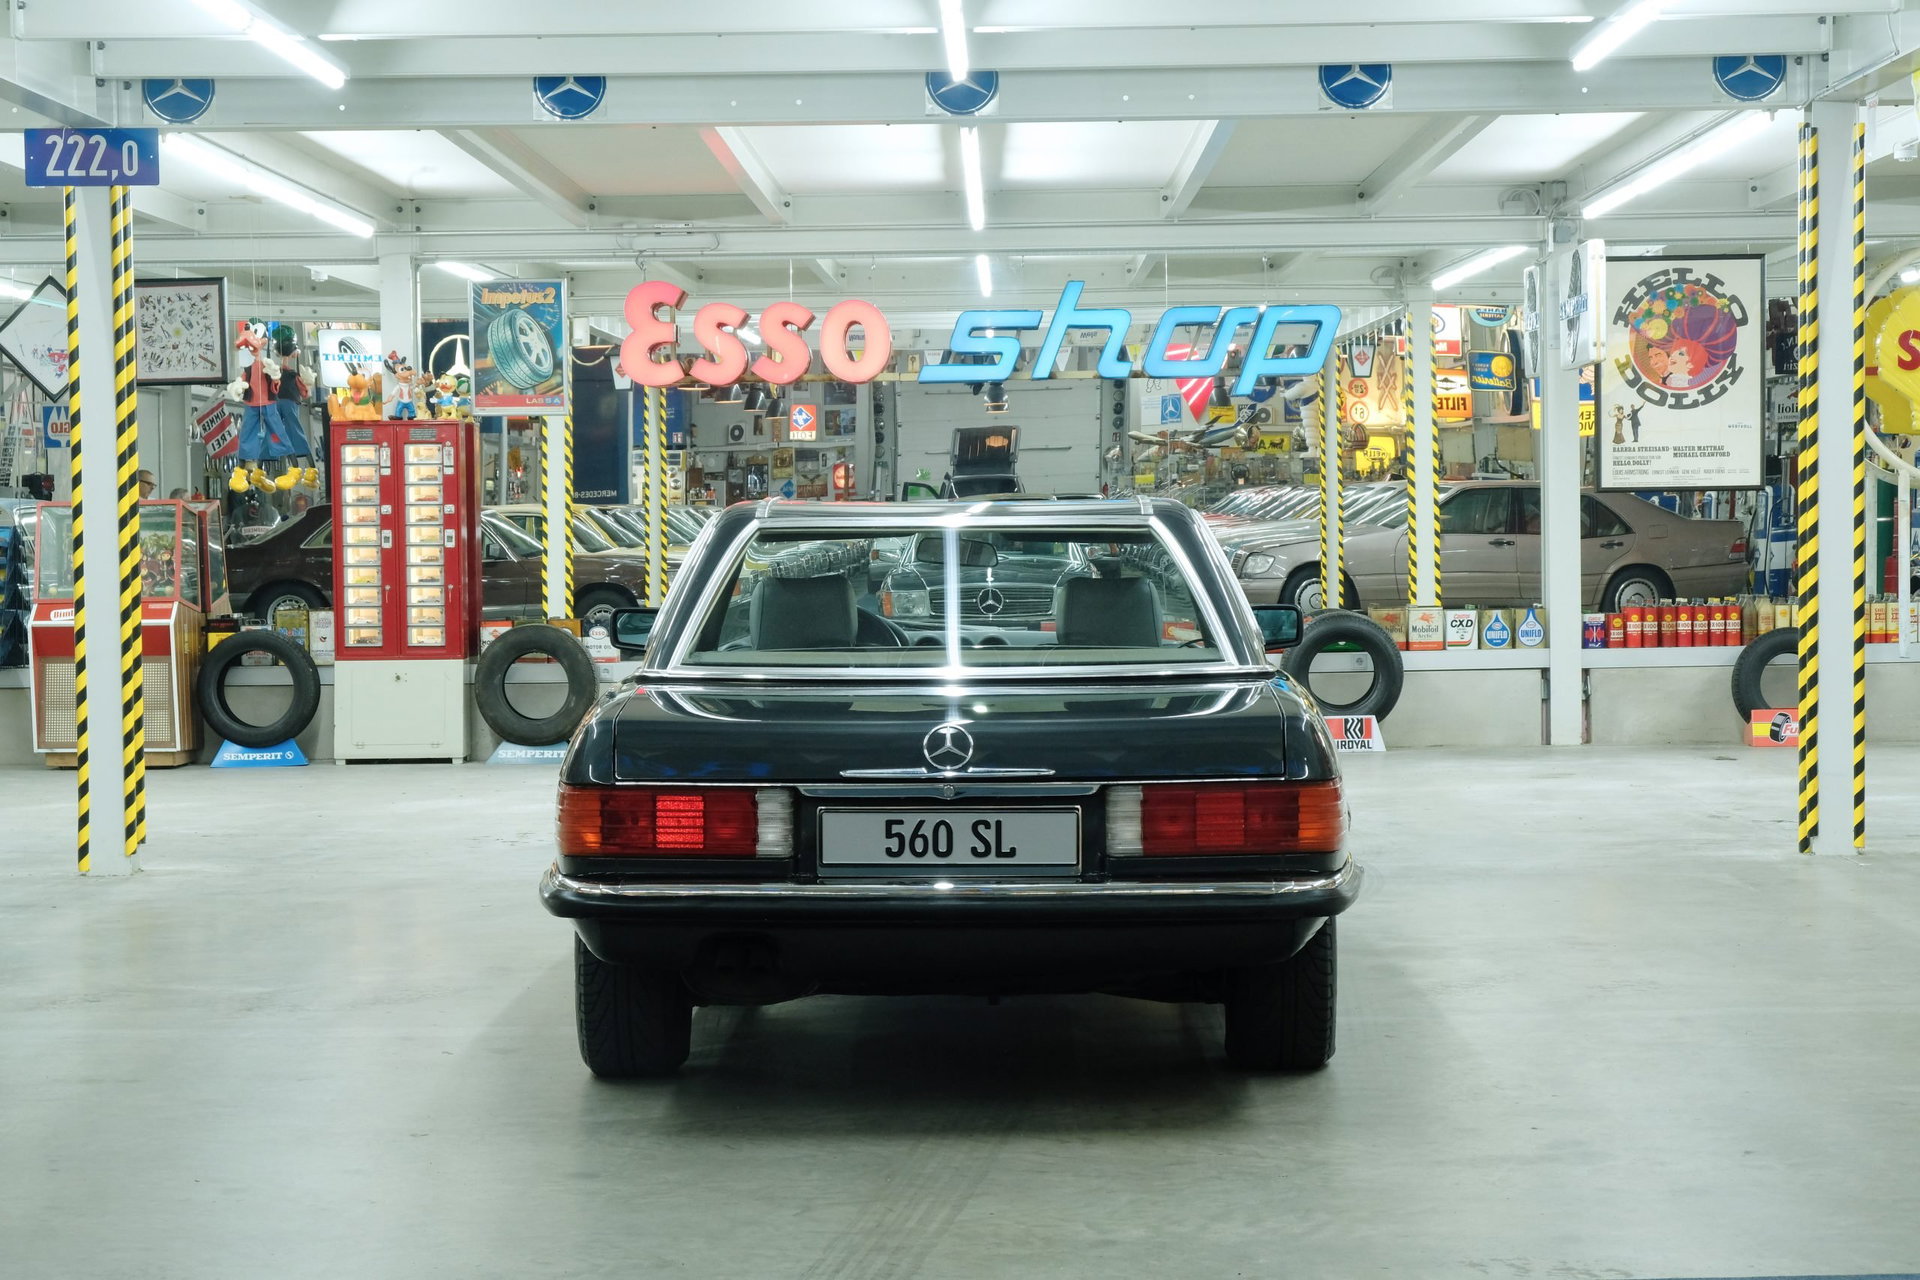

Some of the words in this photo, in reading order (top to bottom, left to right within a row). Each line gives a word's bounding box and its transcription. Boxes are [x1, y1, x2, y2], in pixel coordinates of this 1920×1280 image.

[45, 134, 139, 182] 222,0
[1613, 267, 1749, 328] HELLO
[917, 280, 1342, 397] shop
[1614, 353, 1744, 410] DOLLY
[526, 396, 561, 405] LASSA
[1450, 619, 1474, 628] CXD
[1412, 624, 1439, 633] Mobiloil
[1520, 630, 1542, 638] UNIFLO
[1336, 740, 1373, 750] IROYAL
[224, 752, 283, 761] SEMPERIT
[498, 750, 567, 758] SEMPERIT
[884, 819, 954, 858] 560
[970, 819, 1017, 858] SL
